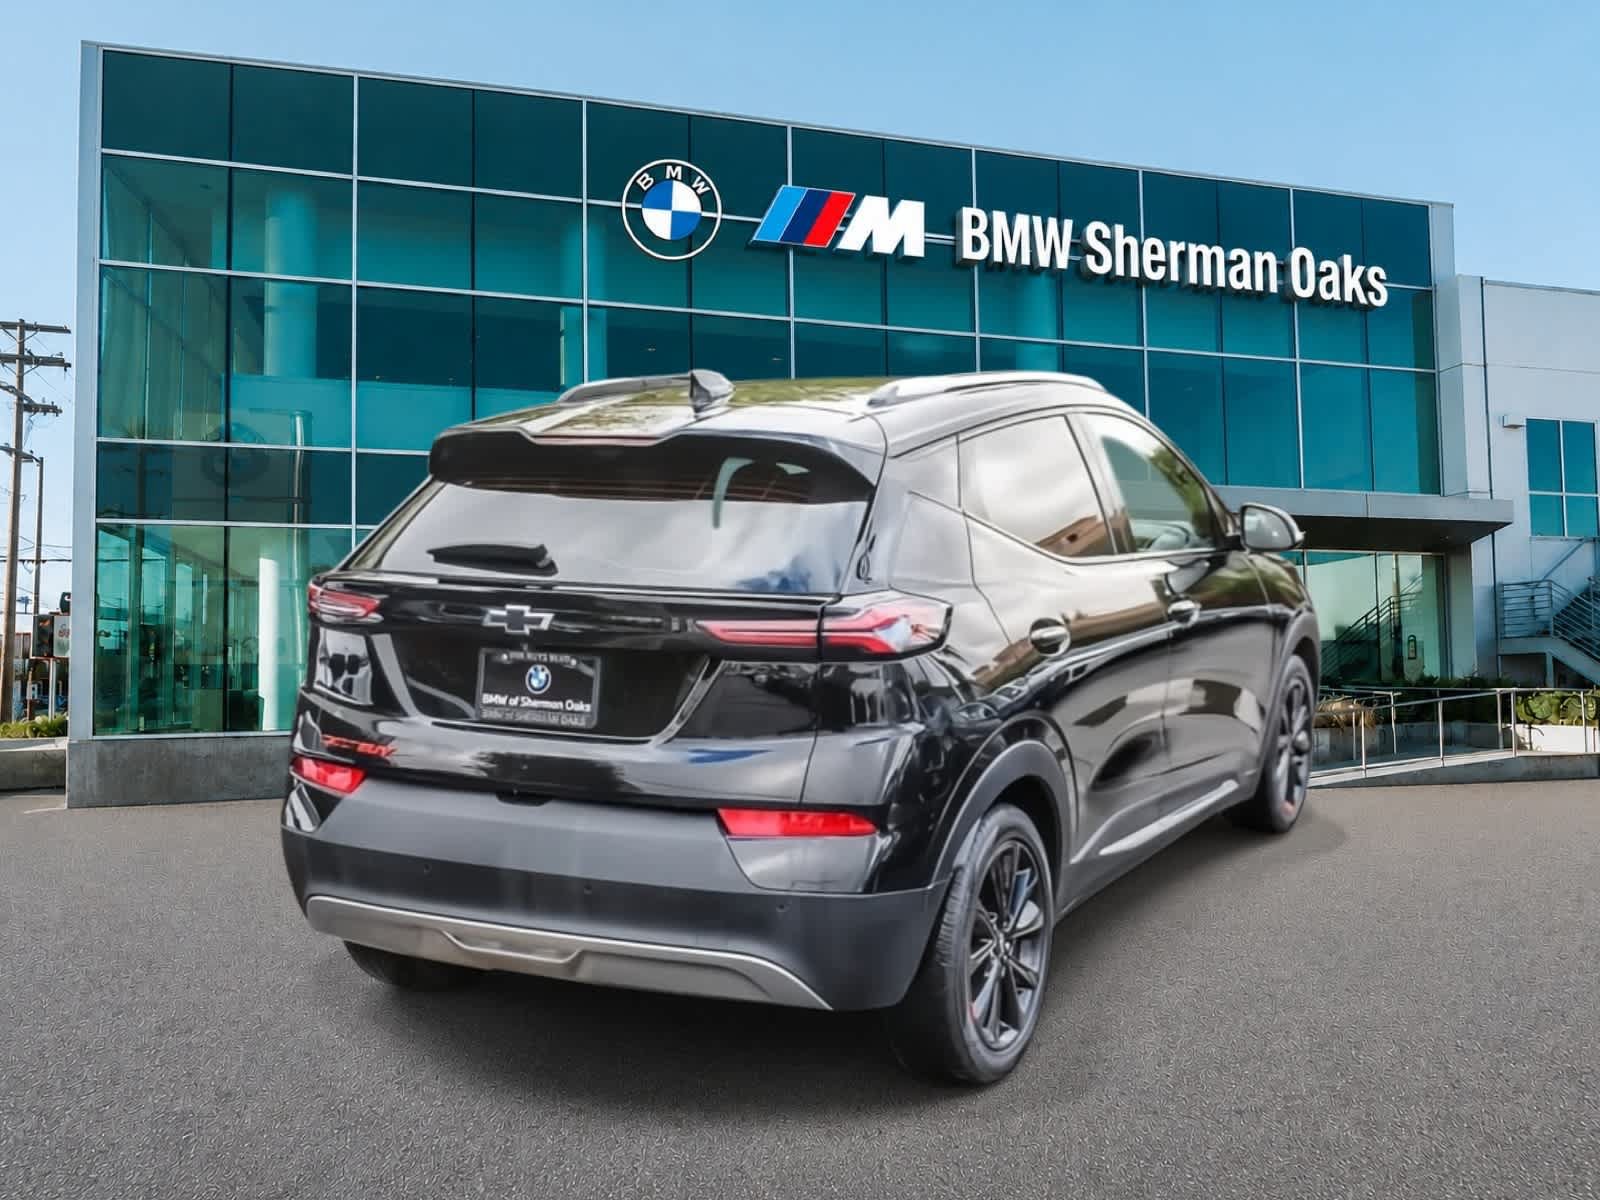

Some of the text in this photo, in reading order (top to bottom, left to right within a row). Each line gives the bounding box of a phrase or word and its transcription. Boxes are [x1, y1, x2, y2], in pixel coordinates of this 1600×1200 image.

[636, 165, 711, 196] BMW
[959, 206, 1388, 308] BMW Sherman Oaks
[482, 693, 592, 712] BMW of Sherman Oaks
